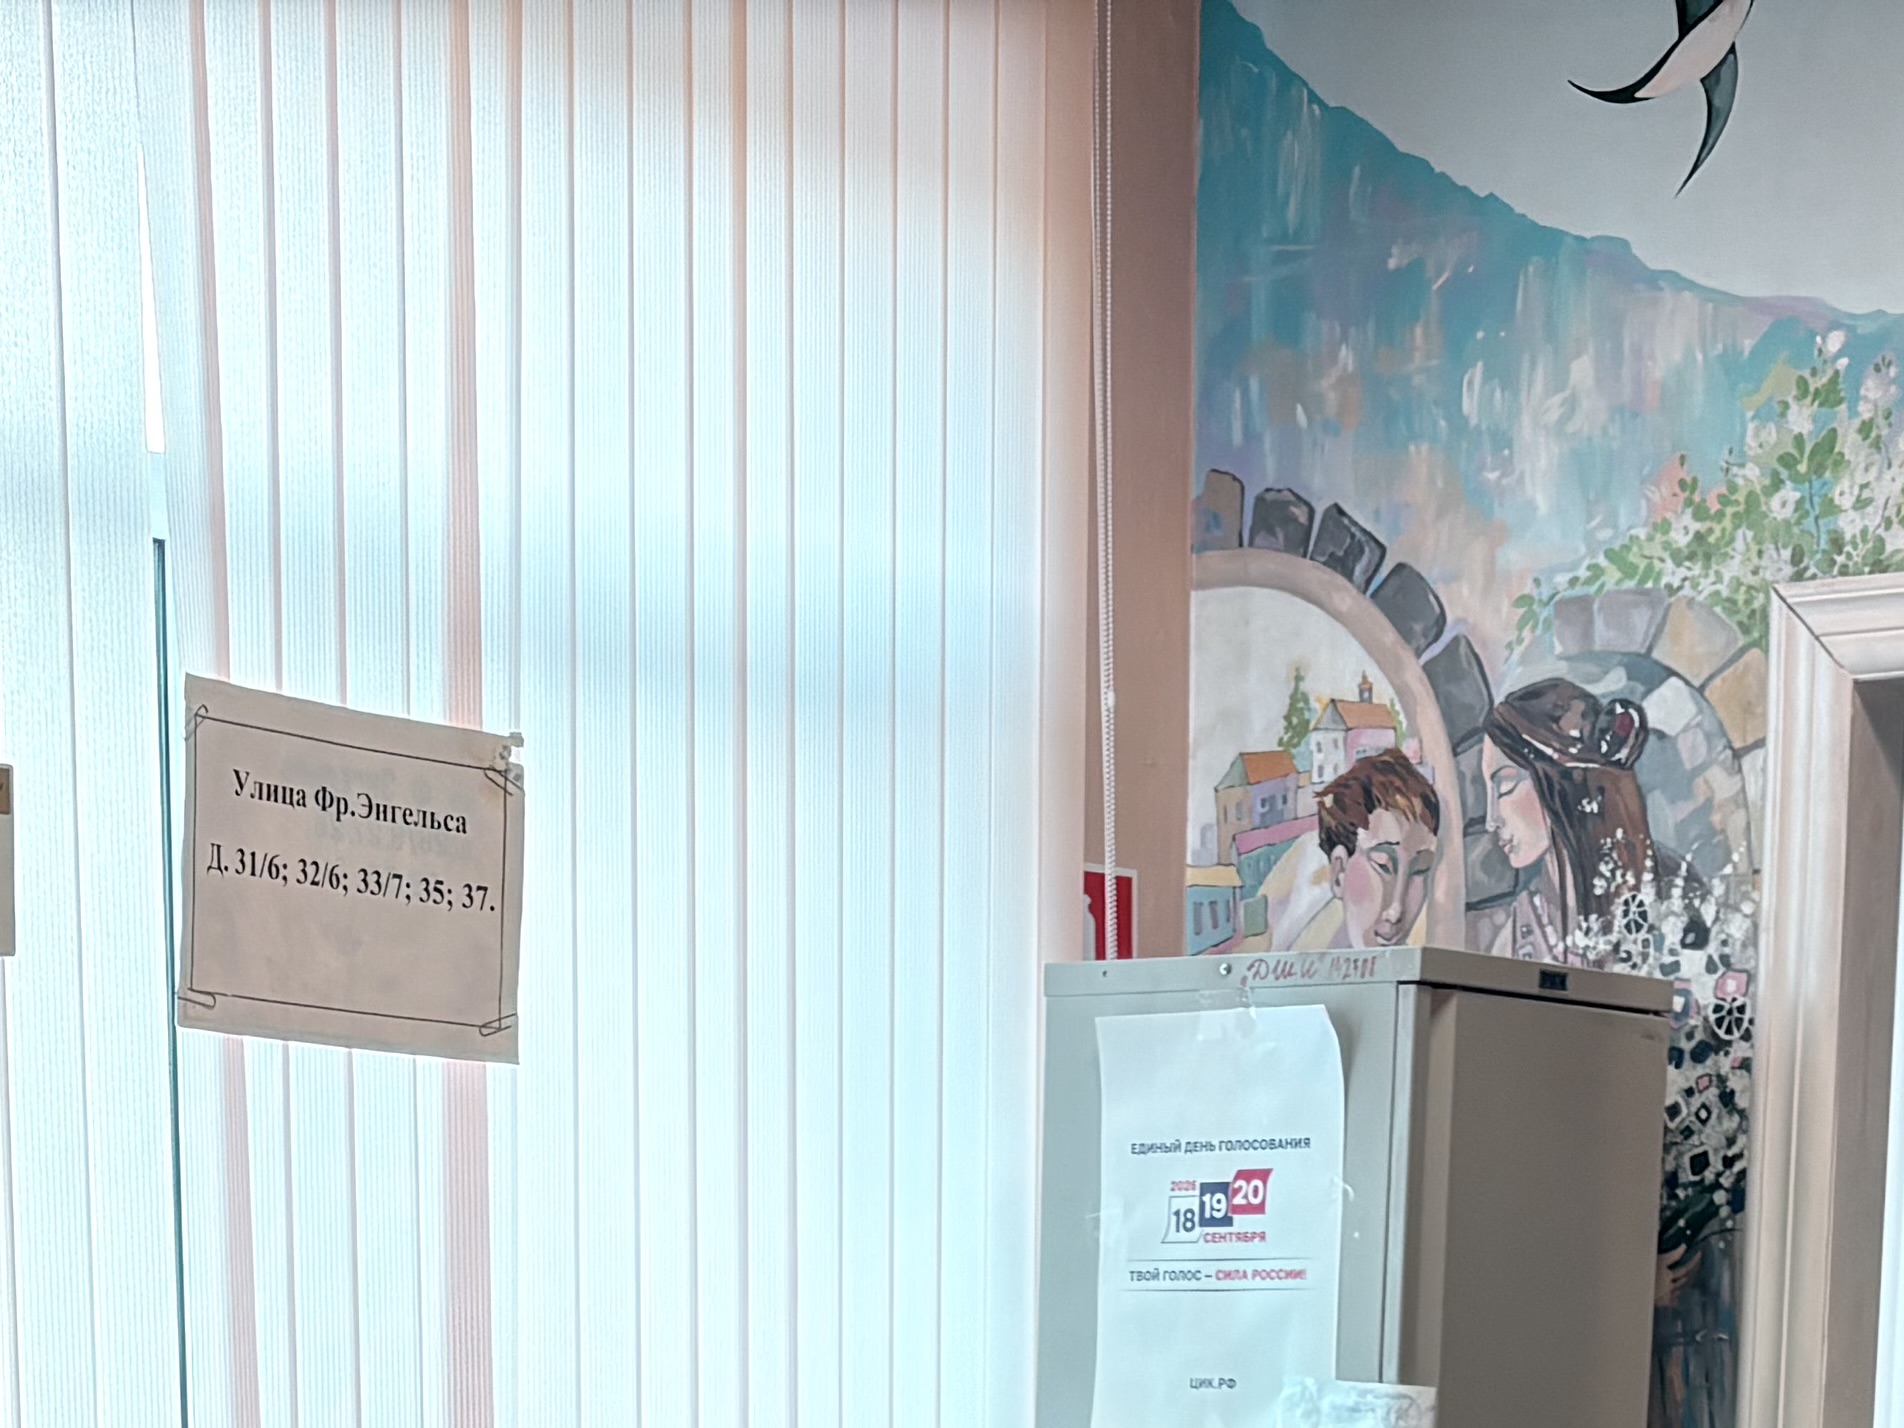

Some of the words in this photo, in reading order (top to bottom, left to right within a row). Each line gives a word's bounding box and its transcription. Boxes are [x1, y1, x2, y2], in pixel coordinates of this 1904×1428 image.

[232, 768, 308, 808] Улица
[313, 785, 468, 836] Фр.Энгельса
[206, 842, 230, 876] Д.
[234, 848, 291, 887] 31/6;
[296, 858, 350, 897] 32/6;
[356, 867, 413, 905] 33/7;
[418, 876, 454, 913] 35;
[461, 884, 497, 913] 37.
[1131, 1139, 1182, 1155] ЕДИНЫЙ
[1184, 1141, 1216, 1154] ДЕНЬ
[1218, 1137, 1312, 1151] ГОЛОСОВАНИЯ
[1232, 1179, 1264, 1205] 20
[1202, 1193, 1227, 1218] 19
[1173, 1208, 1196, 1233] 18
[1203, 1231, 1266, 1243] СЕНТЯБРЯ
[1129, 1268, 1160, 1281] ТВОЙ
[1162, 1270, 1202, 1281] ГОЛОС
[1215, 1269, 1249, 1281] СИЛА
[1251, 1269, 1307, 1281] РОССИИ!
[1189, 1377, 1237, 1389] ЦИК.РФ
